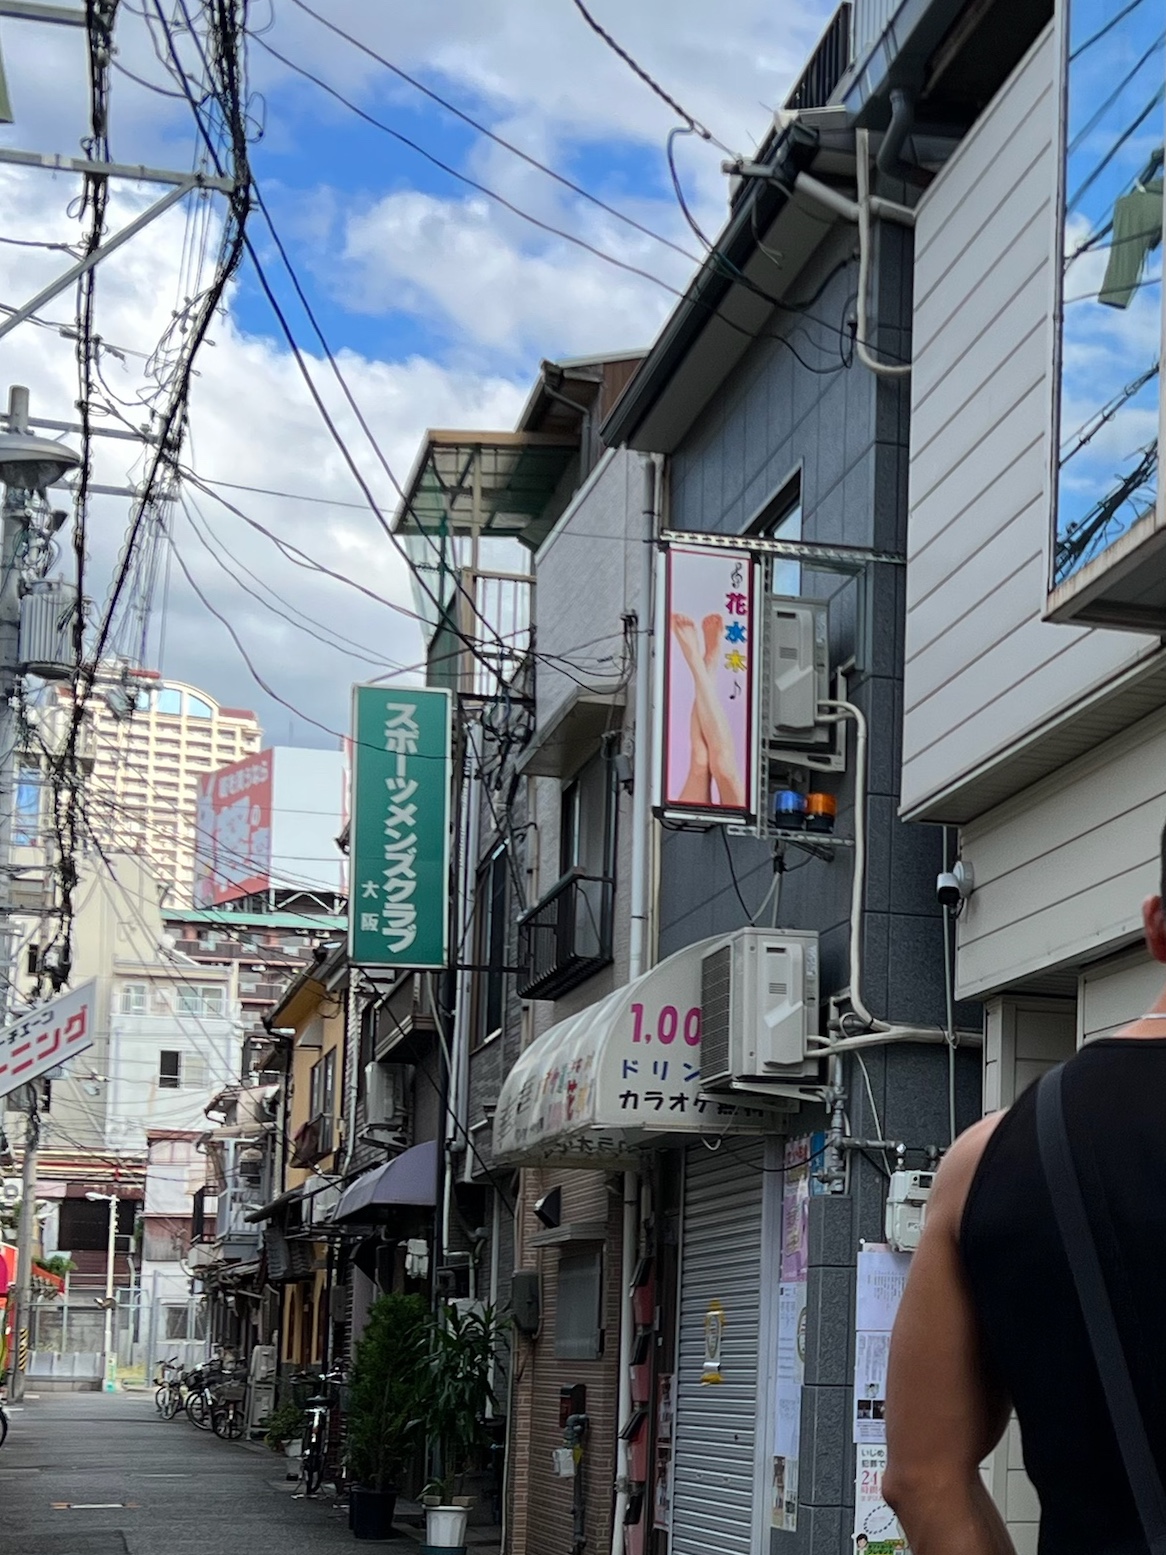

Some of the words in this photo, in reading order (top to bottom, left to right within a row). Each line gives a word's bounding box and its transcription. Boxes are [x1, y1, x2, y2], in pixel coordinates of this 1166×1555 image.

[724, 592, 747, 672] 花水木
[382, 702, 419, 953] スポーツメンズクラブ
[360, 880, 380, 932] 大阪
[861, 1449, 885, 1458] いじめ
